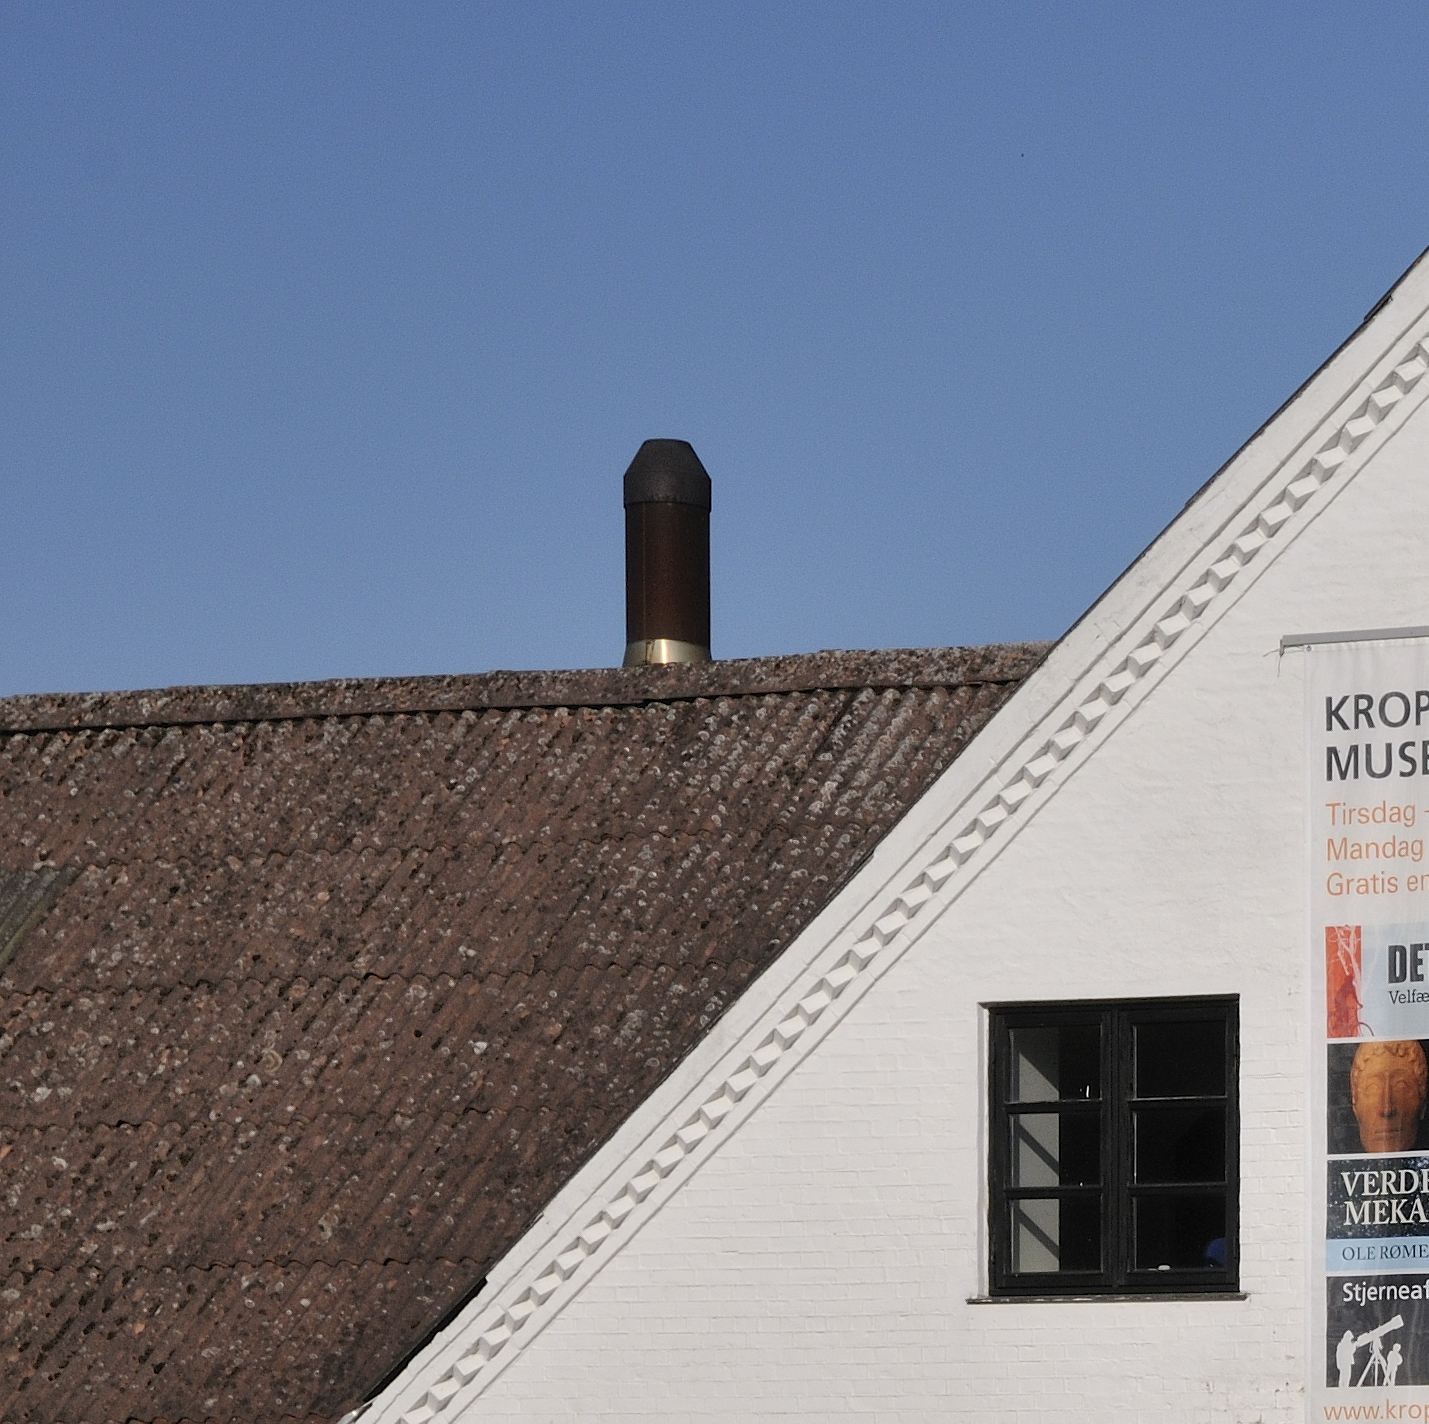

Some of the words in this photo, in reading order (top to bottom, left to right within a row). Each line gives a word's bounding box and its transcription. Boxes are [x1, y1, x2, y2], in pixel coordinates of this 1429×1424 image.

[1326, 801, 1416, 827] Tirsdag
[1326, 836, 1424, 862] Mandag
[1326, 870, 1398, 896] Gratis
[1342, 1246, 1376, 1261] OLE
